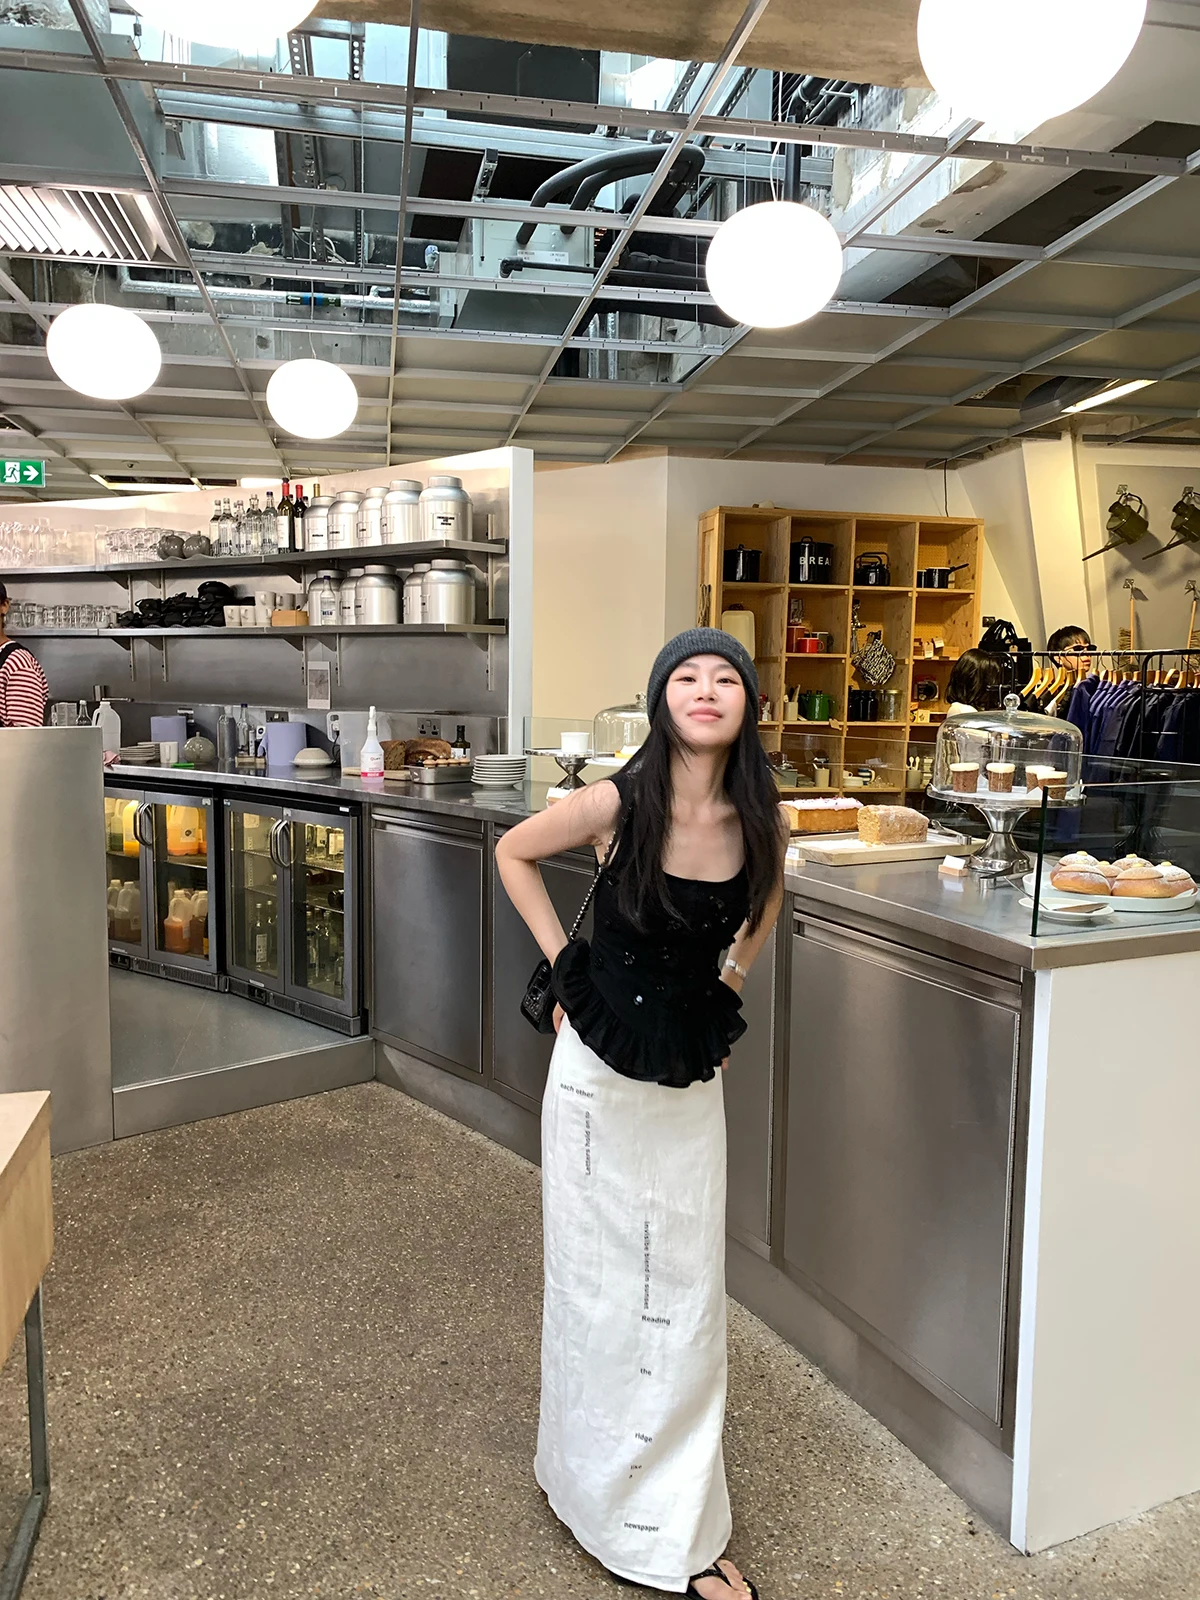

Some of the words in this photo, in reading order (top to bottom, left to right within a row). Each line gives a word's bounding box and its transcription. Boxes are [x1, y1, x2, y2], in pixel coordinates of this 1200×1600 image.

[560, 1082, 574, 1092] each
[575, 1087, 594, 1098] other
[585, 1120, 591, 1129] on
[644, 1274, 651, 1282] in
[641, 1315, 671, 1326] Reading
[640, 1368, 652, 1376] the
[634, 1432, 653, 1443] ridge
[624, 1521, 660, 1532] newspaper
